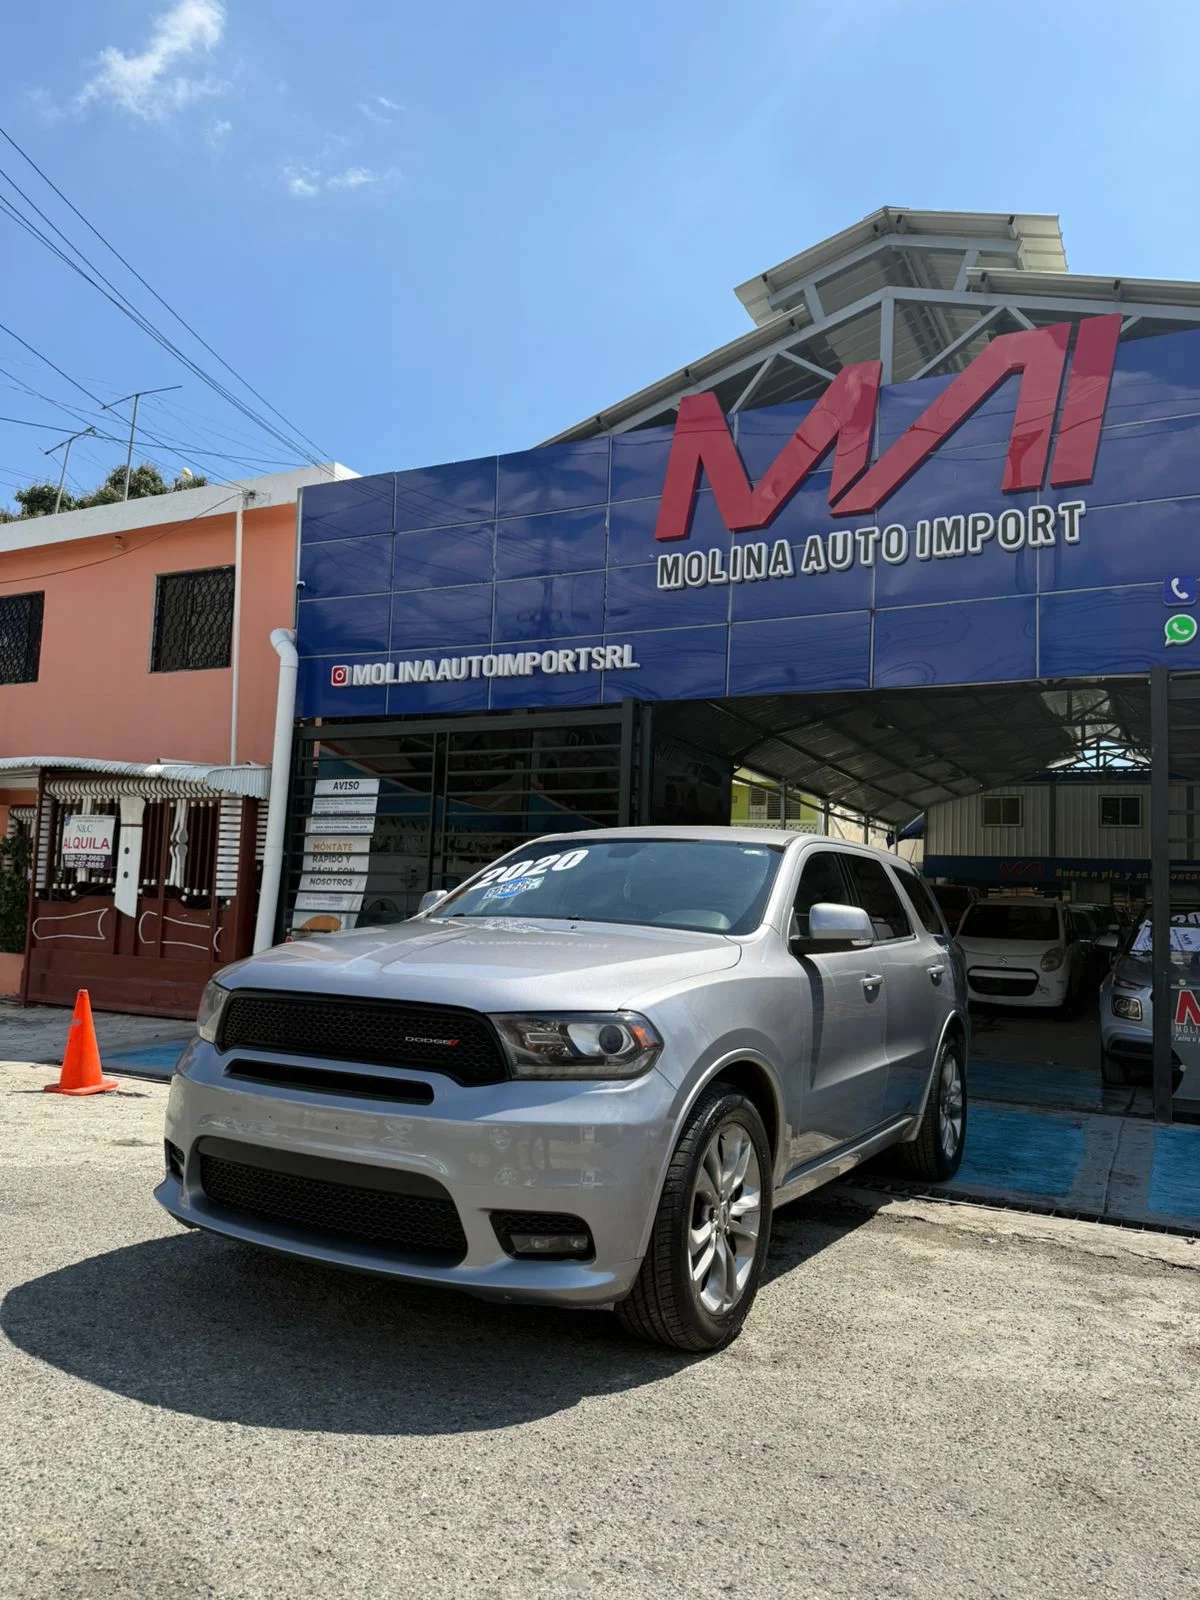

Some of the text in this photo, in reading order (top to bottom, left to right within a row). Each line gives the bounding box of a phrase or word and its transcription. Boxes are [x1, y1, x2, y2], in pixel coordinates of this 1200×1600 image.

[655, 499, 1086, 592] MOLINA AUTO IMPORT
[351, 643, 641, 687] MOLINAAUTOIMPORTSRL
[333, 780, 360, 790] AVISO
[63, 836, 111, 850] ALQUILA
[468, 849, 590, 892] 2020
[310, 877, 353, 886] NOSOTROS
[405, 1036, 449, 1045] DODGE
